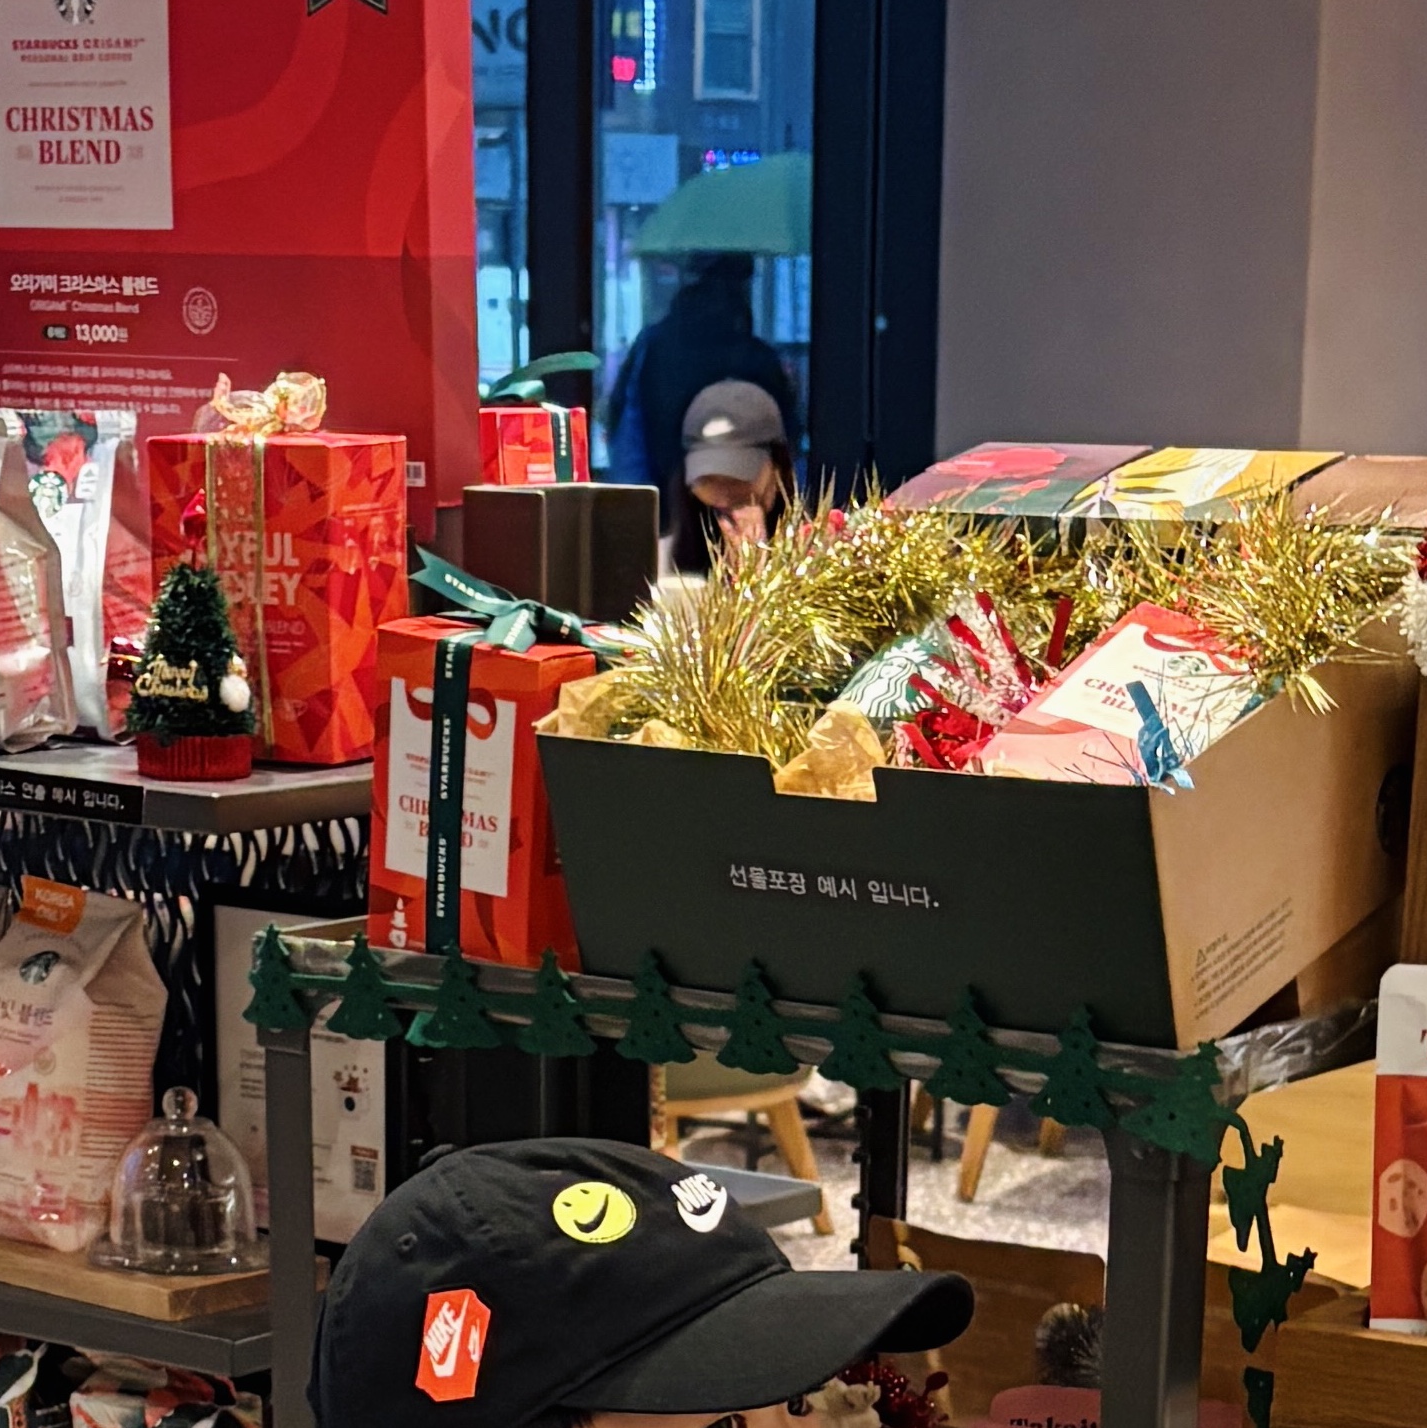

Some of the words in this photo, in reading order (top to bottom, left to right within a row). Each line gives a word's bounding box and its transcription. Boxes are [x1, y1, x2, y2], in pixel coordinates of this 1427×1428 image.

[6, 106, 154, 132] CHRISTMAS
[39, 140, 121, 165] BLEND
[10, 274, 57, 293] 오리가미
[60, 275, 120, 294] 크리스마스
[439, 713, 452, 800] STARBUCKS
[82, 789, 125, 810] 입니다.
[436, 832, 450, 918] STARBUCKS
[729, 864, 807, 896] 선물포장
[817, 875, 858, 901] 예시
[868, 880, 940, 909] 입니다.
[671, 1173, 719, 1213] NIKE
[423, 1301, 461, 1363] NIKE
